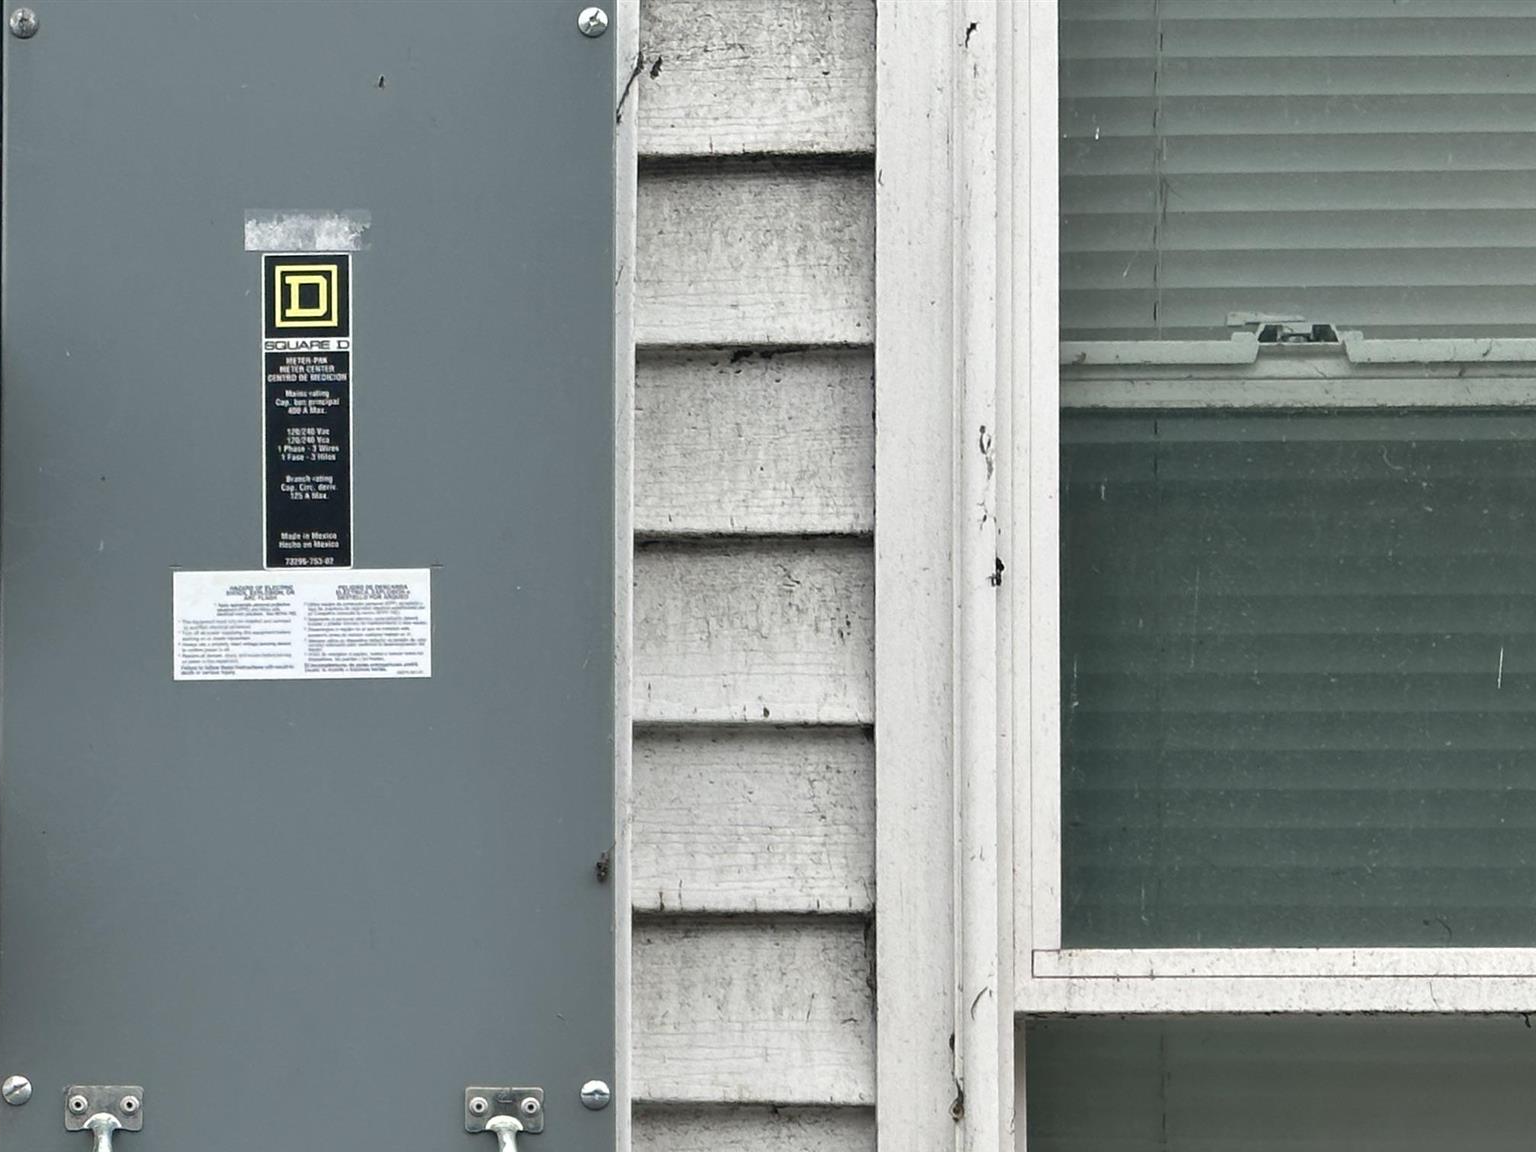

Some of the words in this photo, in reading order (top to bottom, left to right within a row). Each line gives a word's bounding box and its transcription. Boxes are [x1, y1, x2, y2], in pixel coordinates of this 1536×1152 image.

[265, 340, 331, 350] SQUARE
[337, 340, 350, 349] D
[267, 374, 297, 382] CENTRO
[281, 532, 301, 540] Made
